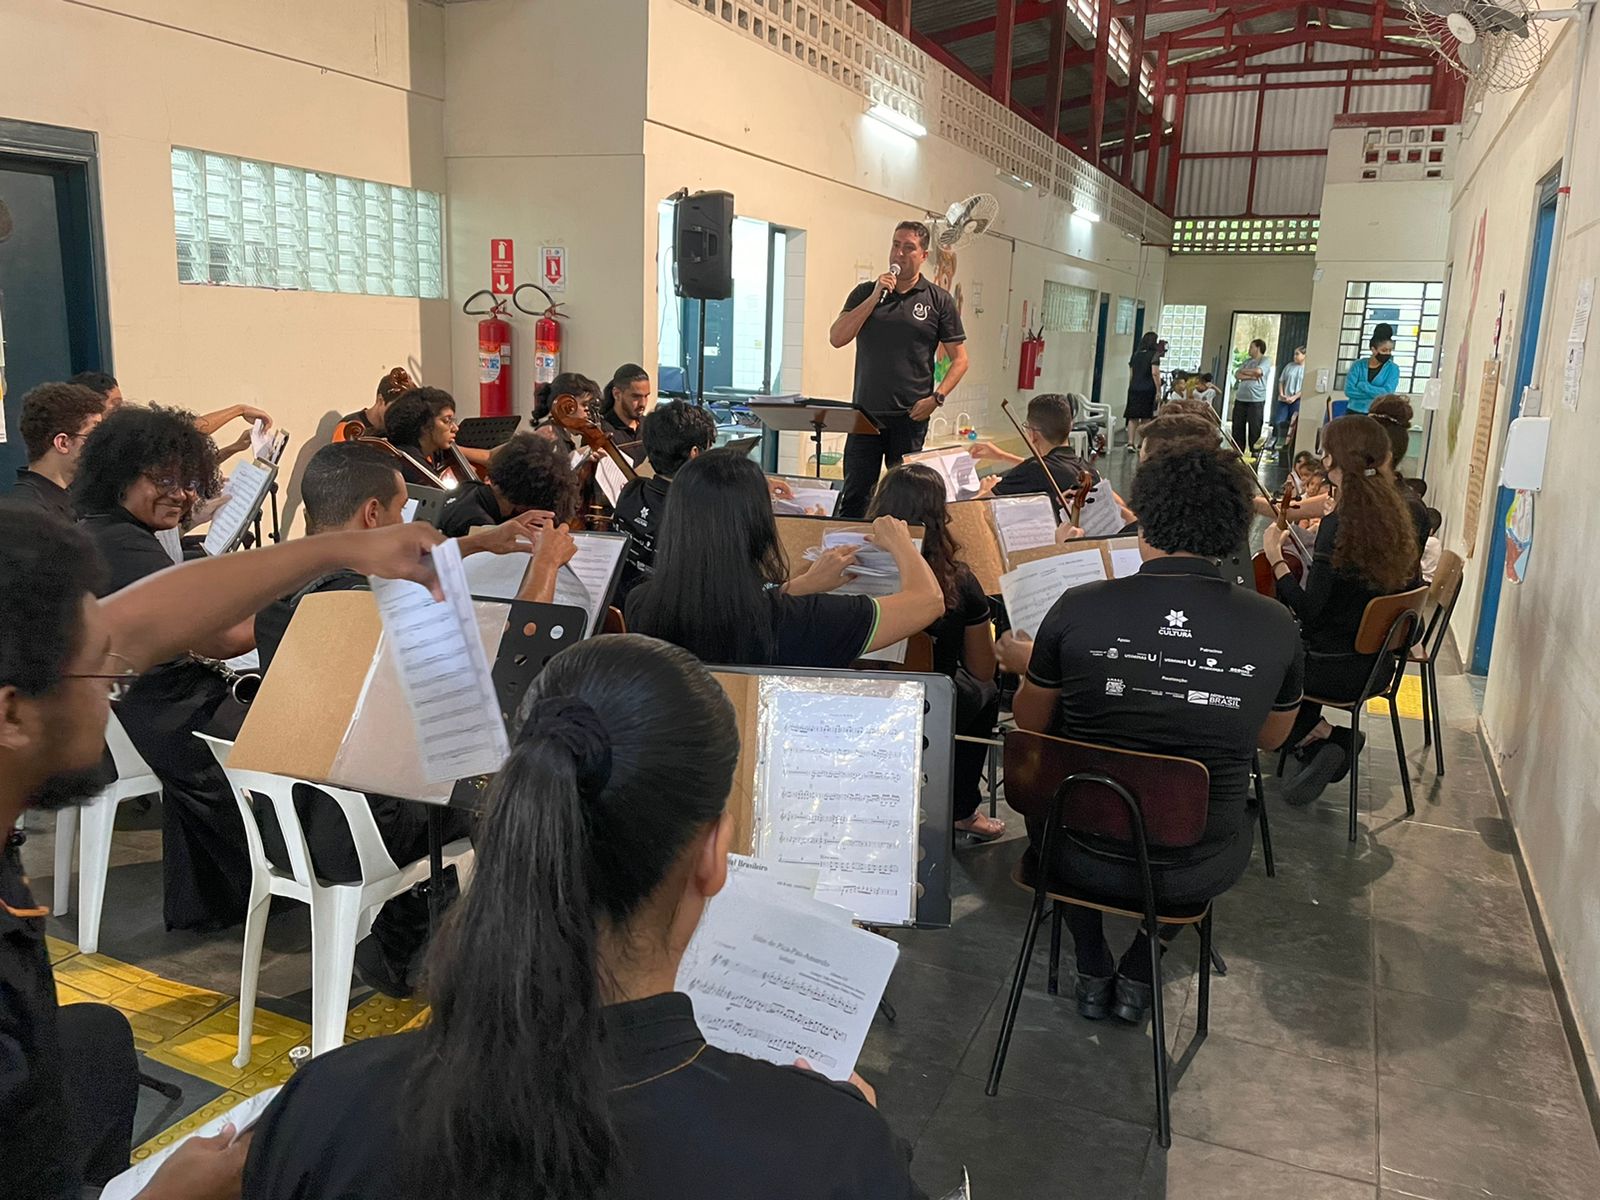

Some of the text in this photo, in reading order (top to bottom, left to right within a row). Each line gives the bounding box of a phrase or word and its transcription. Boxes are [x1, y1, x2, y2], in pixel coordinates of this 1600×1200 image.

[1158, 629, 1193, 638] CULTURA
[1209, 696, 1240, 707] BRASIL
[738, 859, 768, 871] Brasileiro
